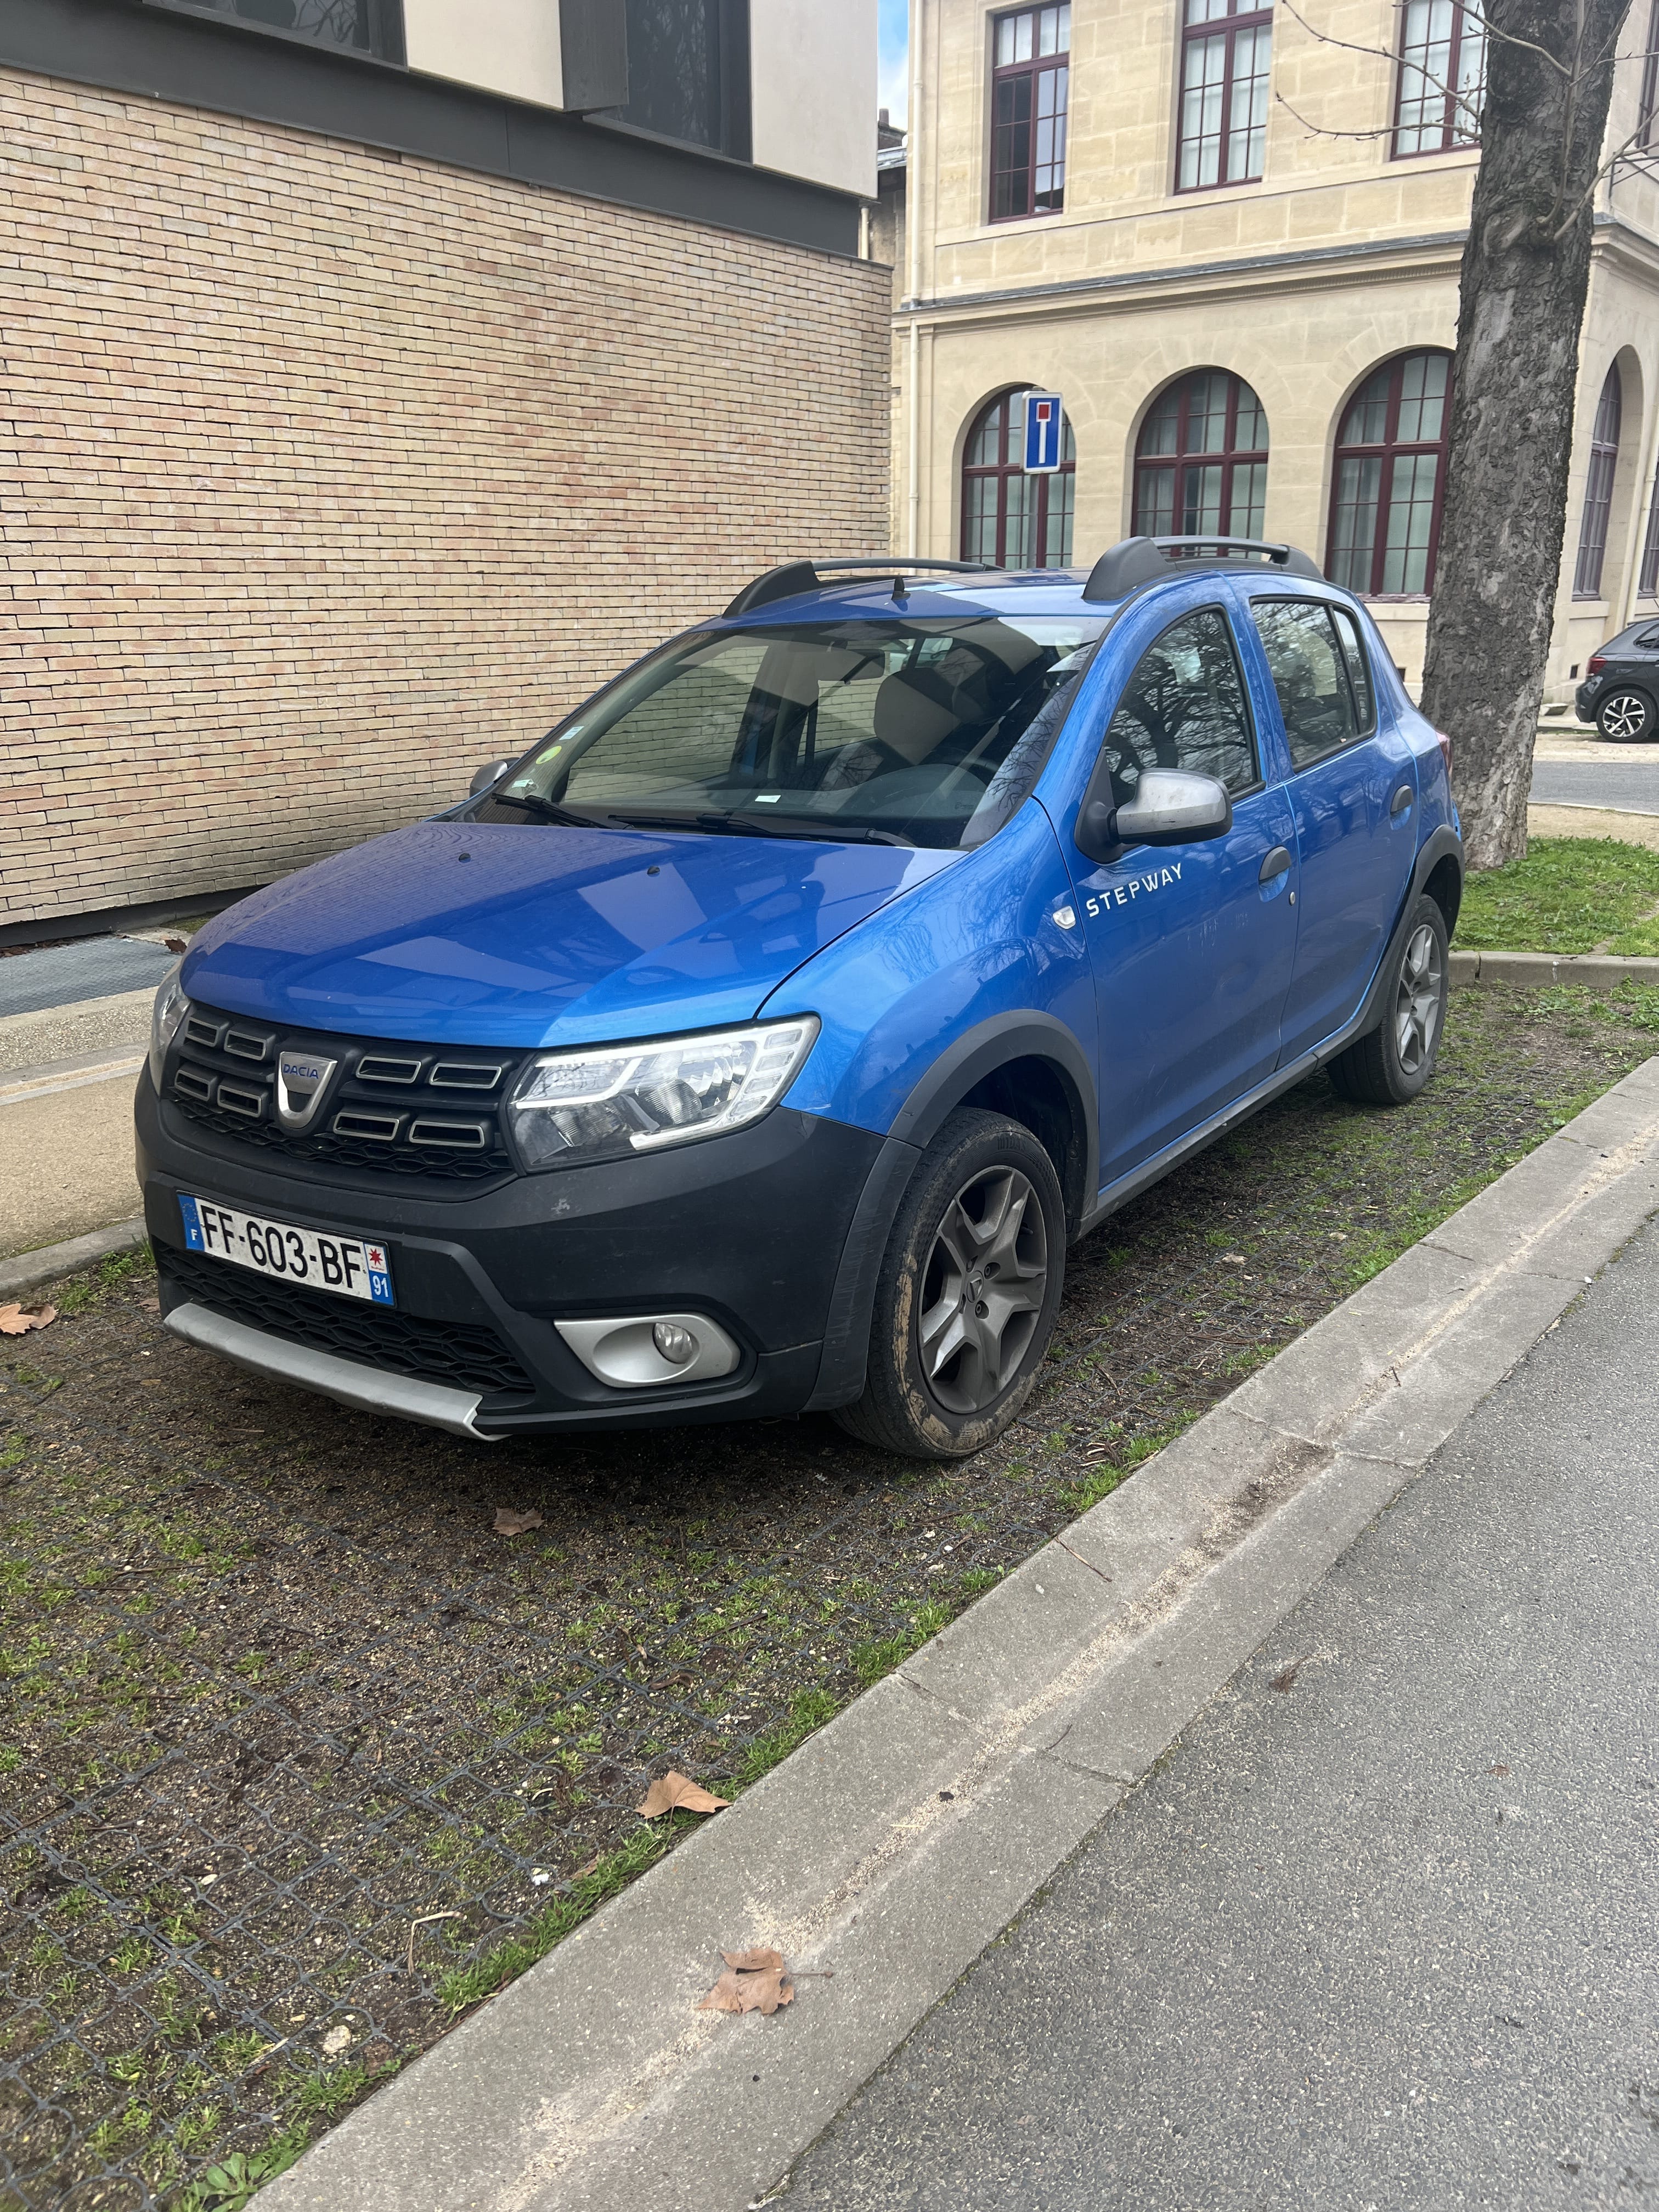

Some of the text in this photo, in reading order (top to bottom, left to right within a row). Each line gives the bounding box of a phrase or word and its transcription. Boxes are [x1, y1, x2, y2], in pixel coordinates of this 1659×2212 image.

[1086, 863, 1182, 917] STEPWAY
[283, 1064, 319, 1079] DACIA
[191, 1229, 198, 1241] F
[201, 1205, 361, 1288] FF-603-BF
[373, 1275, 389, 1298] 91
